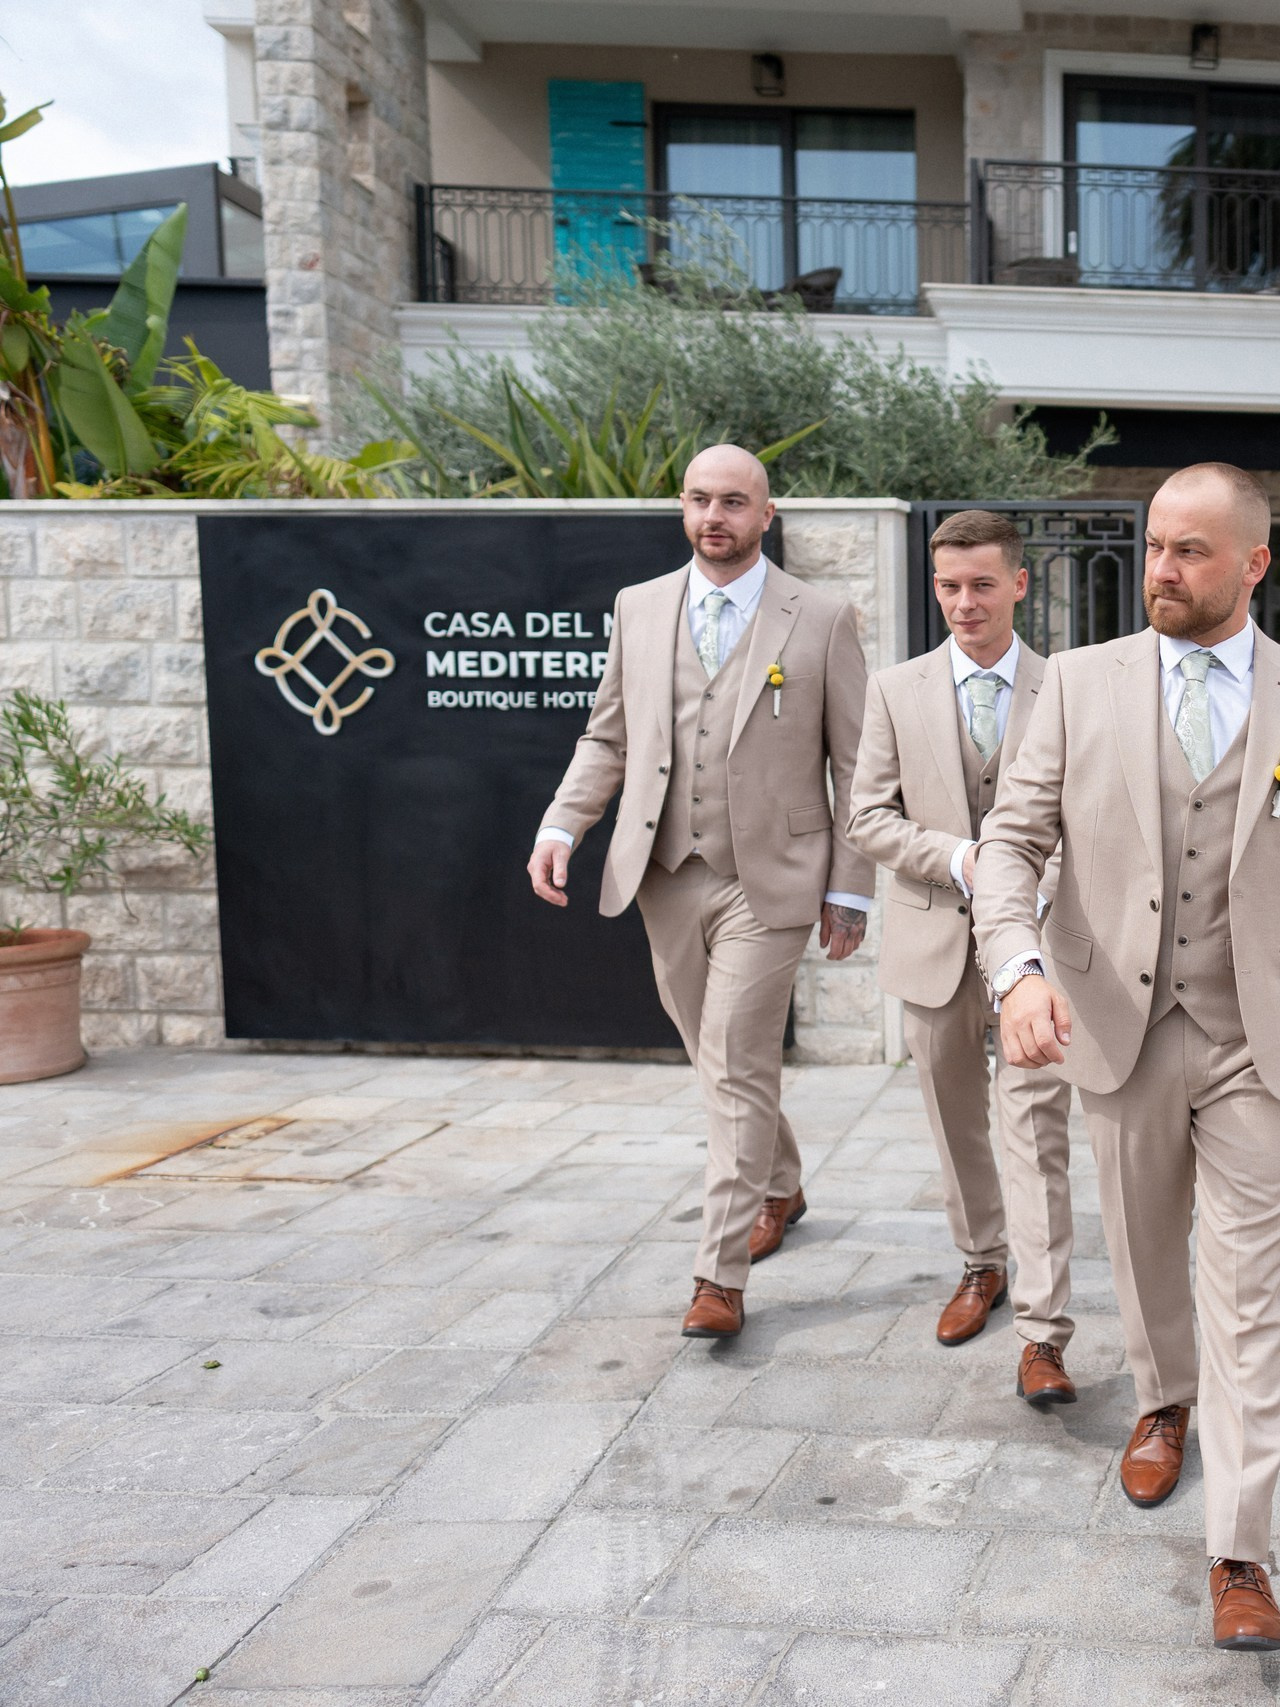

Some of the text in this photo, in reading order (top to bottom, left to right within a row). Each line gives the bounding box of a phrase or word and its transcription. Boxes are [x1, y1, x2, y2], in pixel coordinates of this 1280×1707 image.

[424, 612, 516, 638] CASA
[525, 612, 593, 638] DEL
[427, 690, 537, 711] BOUTIQUE
